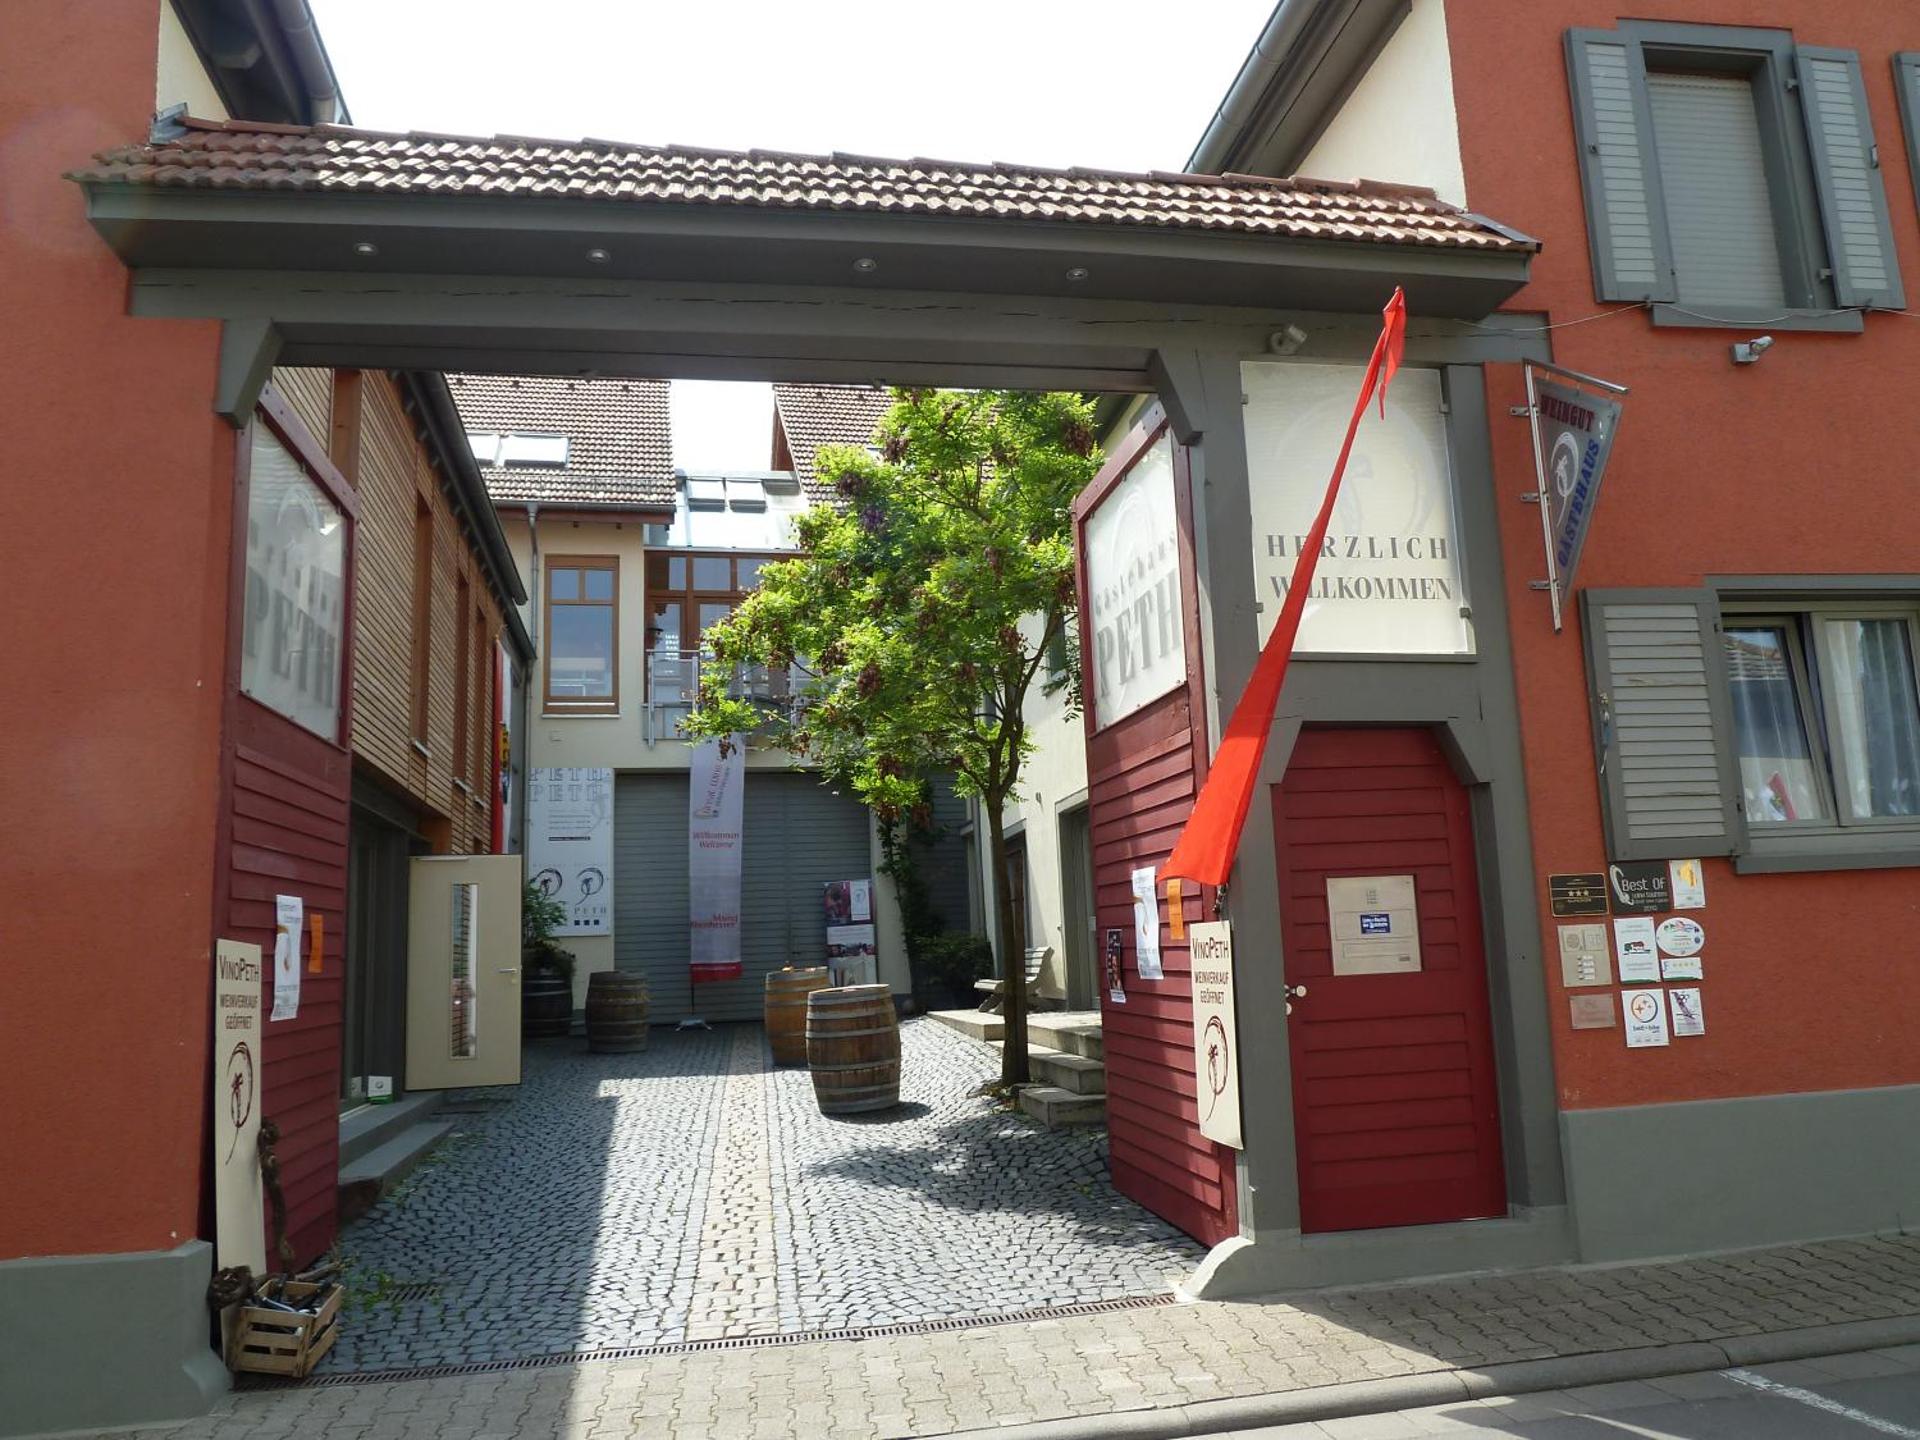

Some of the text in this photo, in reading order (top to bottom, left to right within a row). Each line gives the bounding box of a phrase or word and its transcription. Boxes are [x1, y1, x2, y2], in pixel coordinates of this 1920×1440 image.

[1270, 576, 1452, 600] WLLKOMMEN
[1096, 568, 1182, 698] PETH
[1621, 878, 1648, 892] Best
